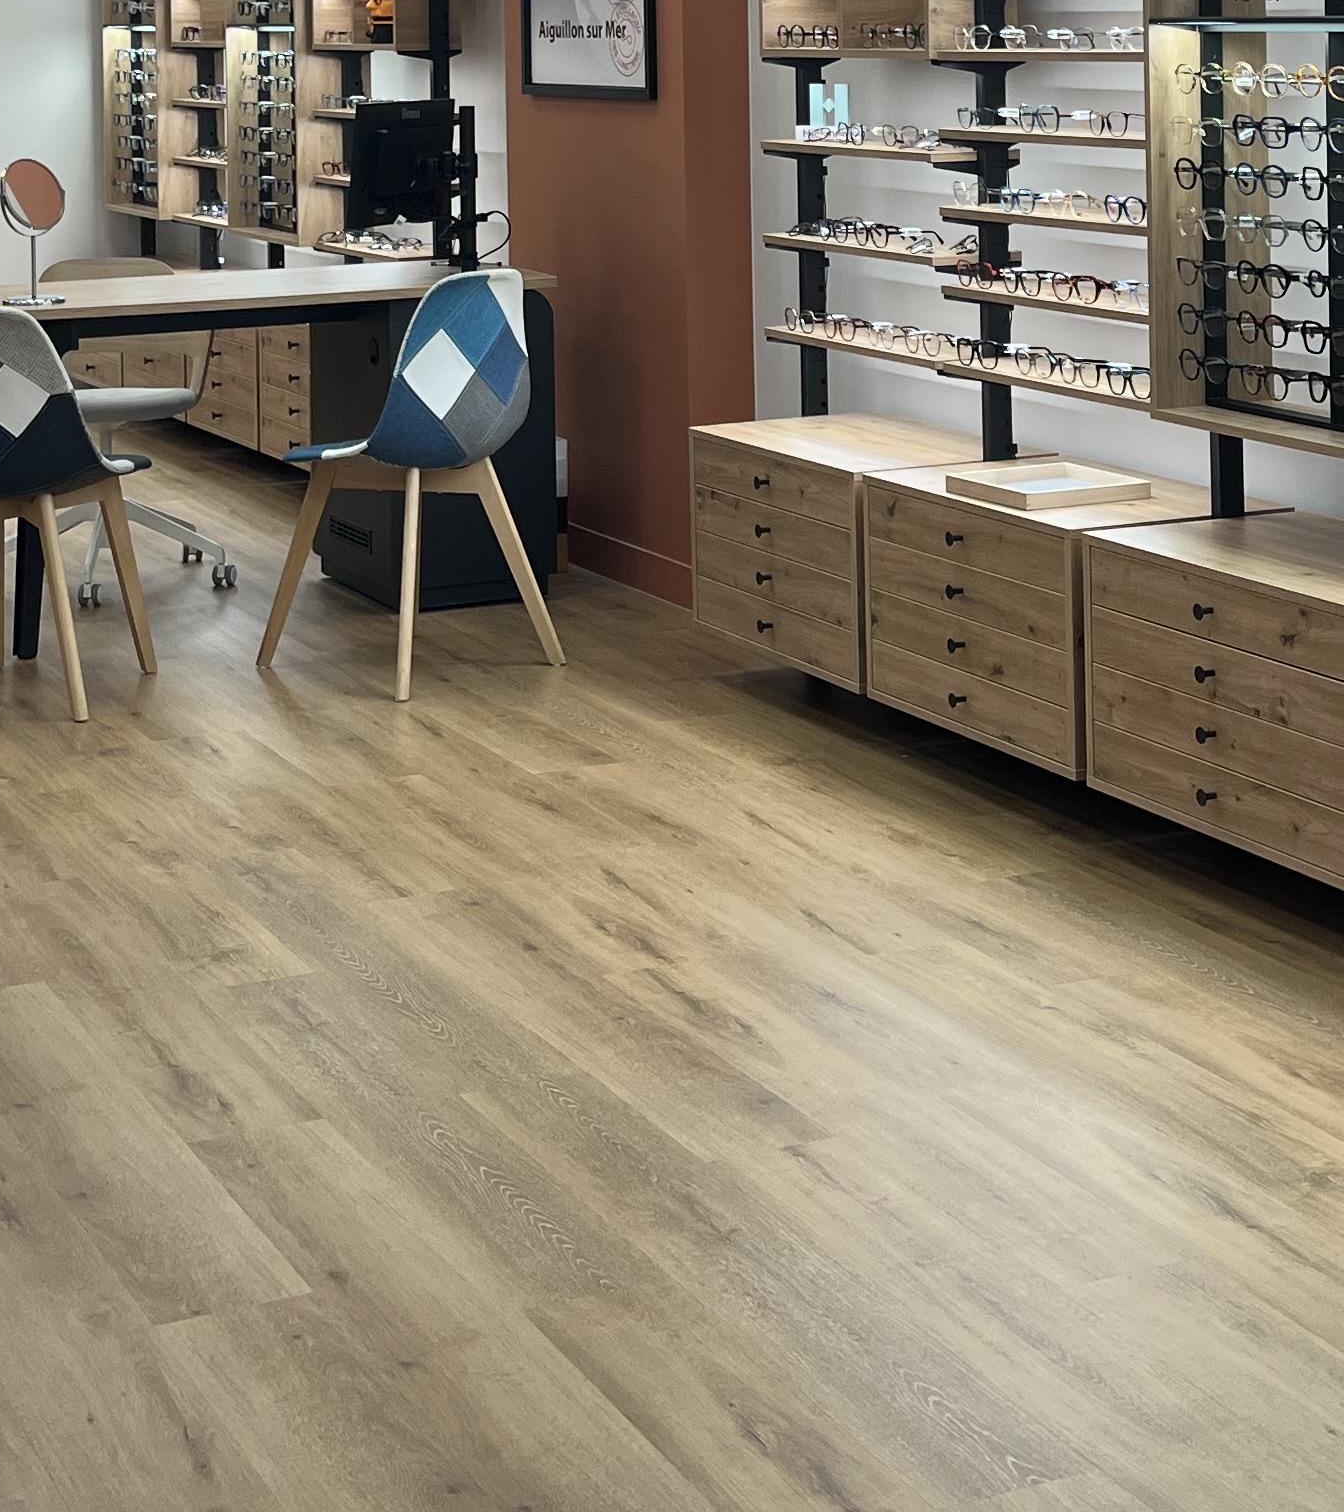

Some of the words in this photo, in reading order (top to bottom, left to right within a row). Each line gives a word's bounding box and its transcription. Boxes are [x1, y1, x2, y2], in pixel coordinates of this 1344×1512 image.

[538, 20, 585, 43] Aiguillon
[586, 25, 603, 39] sur
[605, 21, 627, 39] Mer
